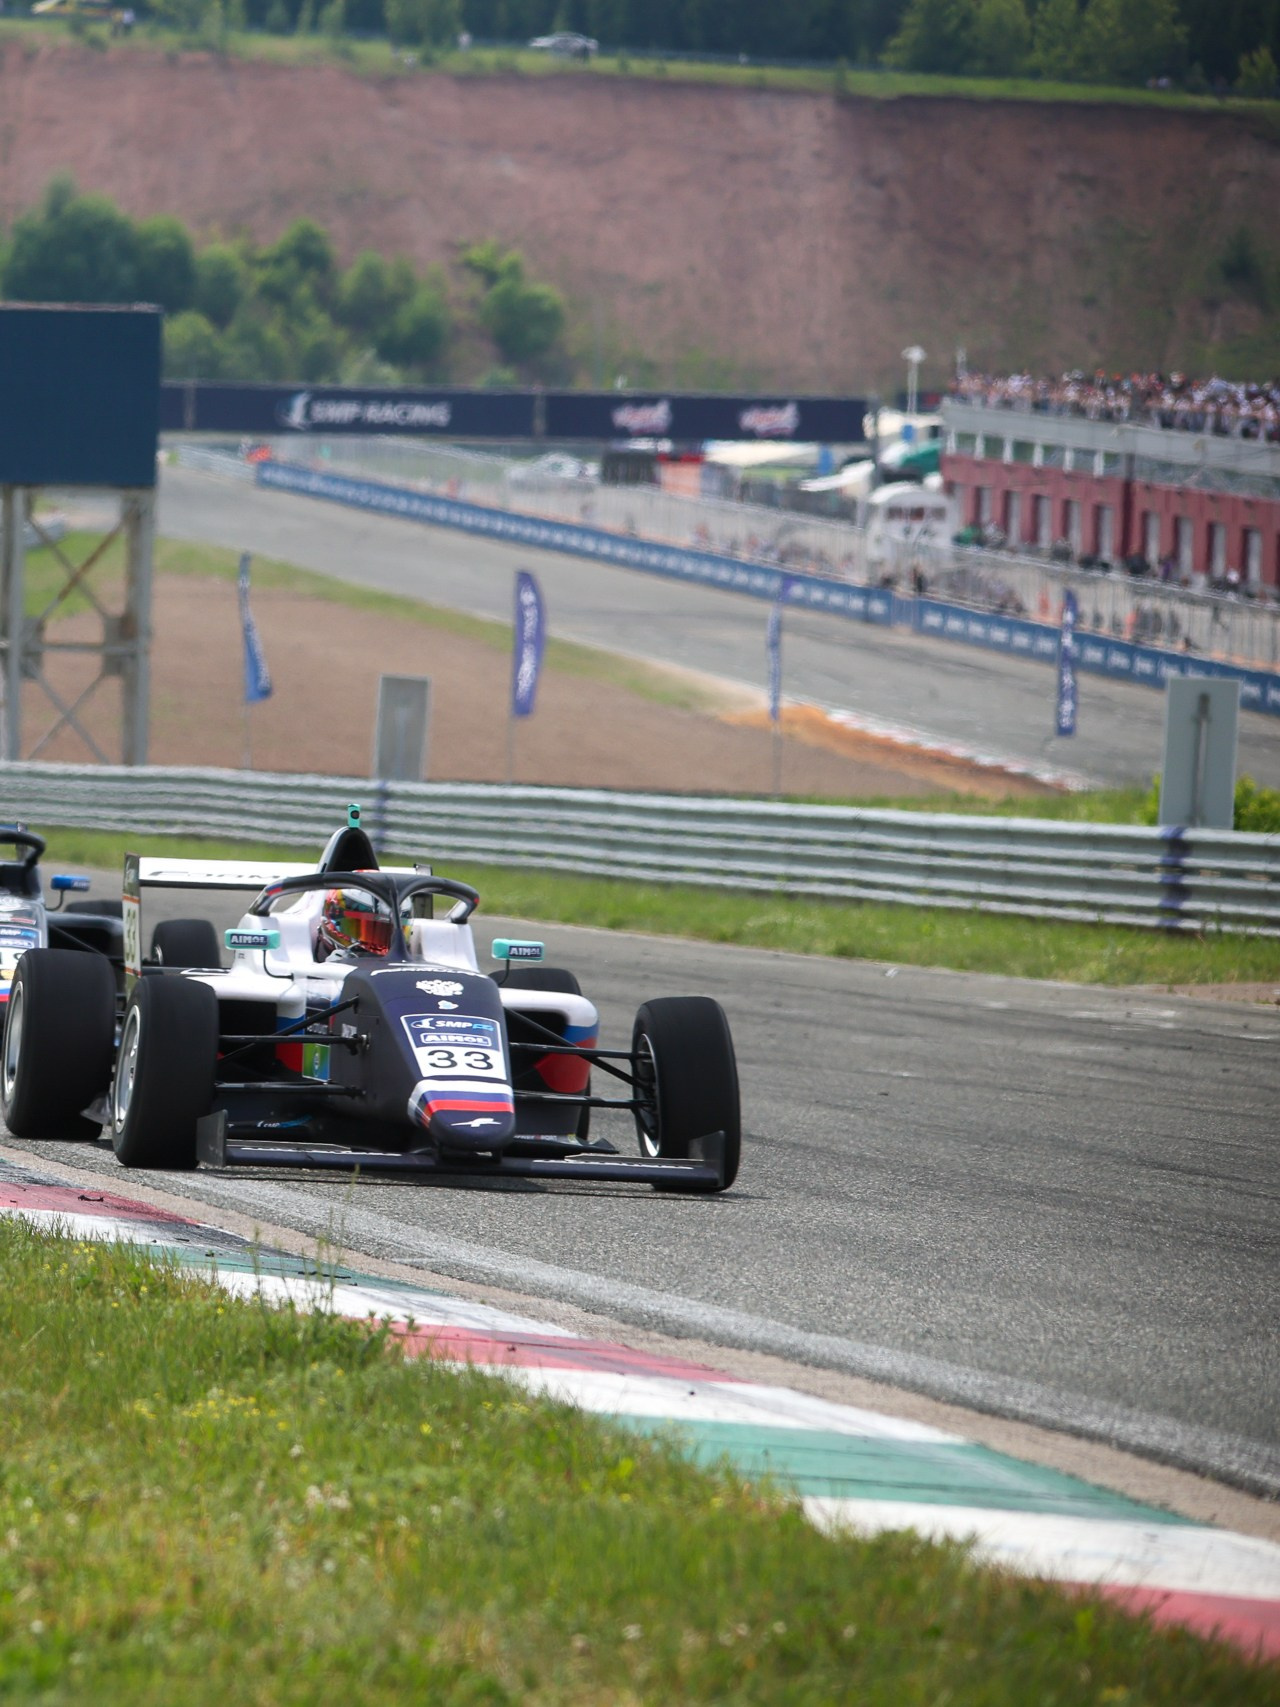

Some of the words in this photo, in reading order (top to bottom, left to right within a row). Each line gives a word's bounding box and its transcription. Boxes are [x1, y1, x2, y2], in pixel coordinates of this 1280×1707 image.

[230, 934, 268, 945] AIMOL
[509, 946, 541, 956] AIMOL
[424, 1034, 489, 1044] AIMOL
[427, 1050, 494, 1070] 33
